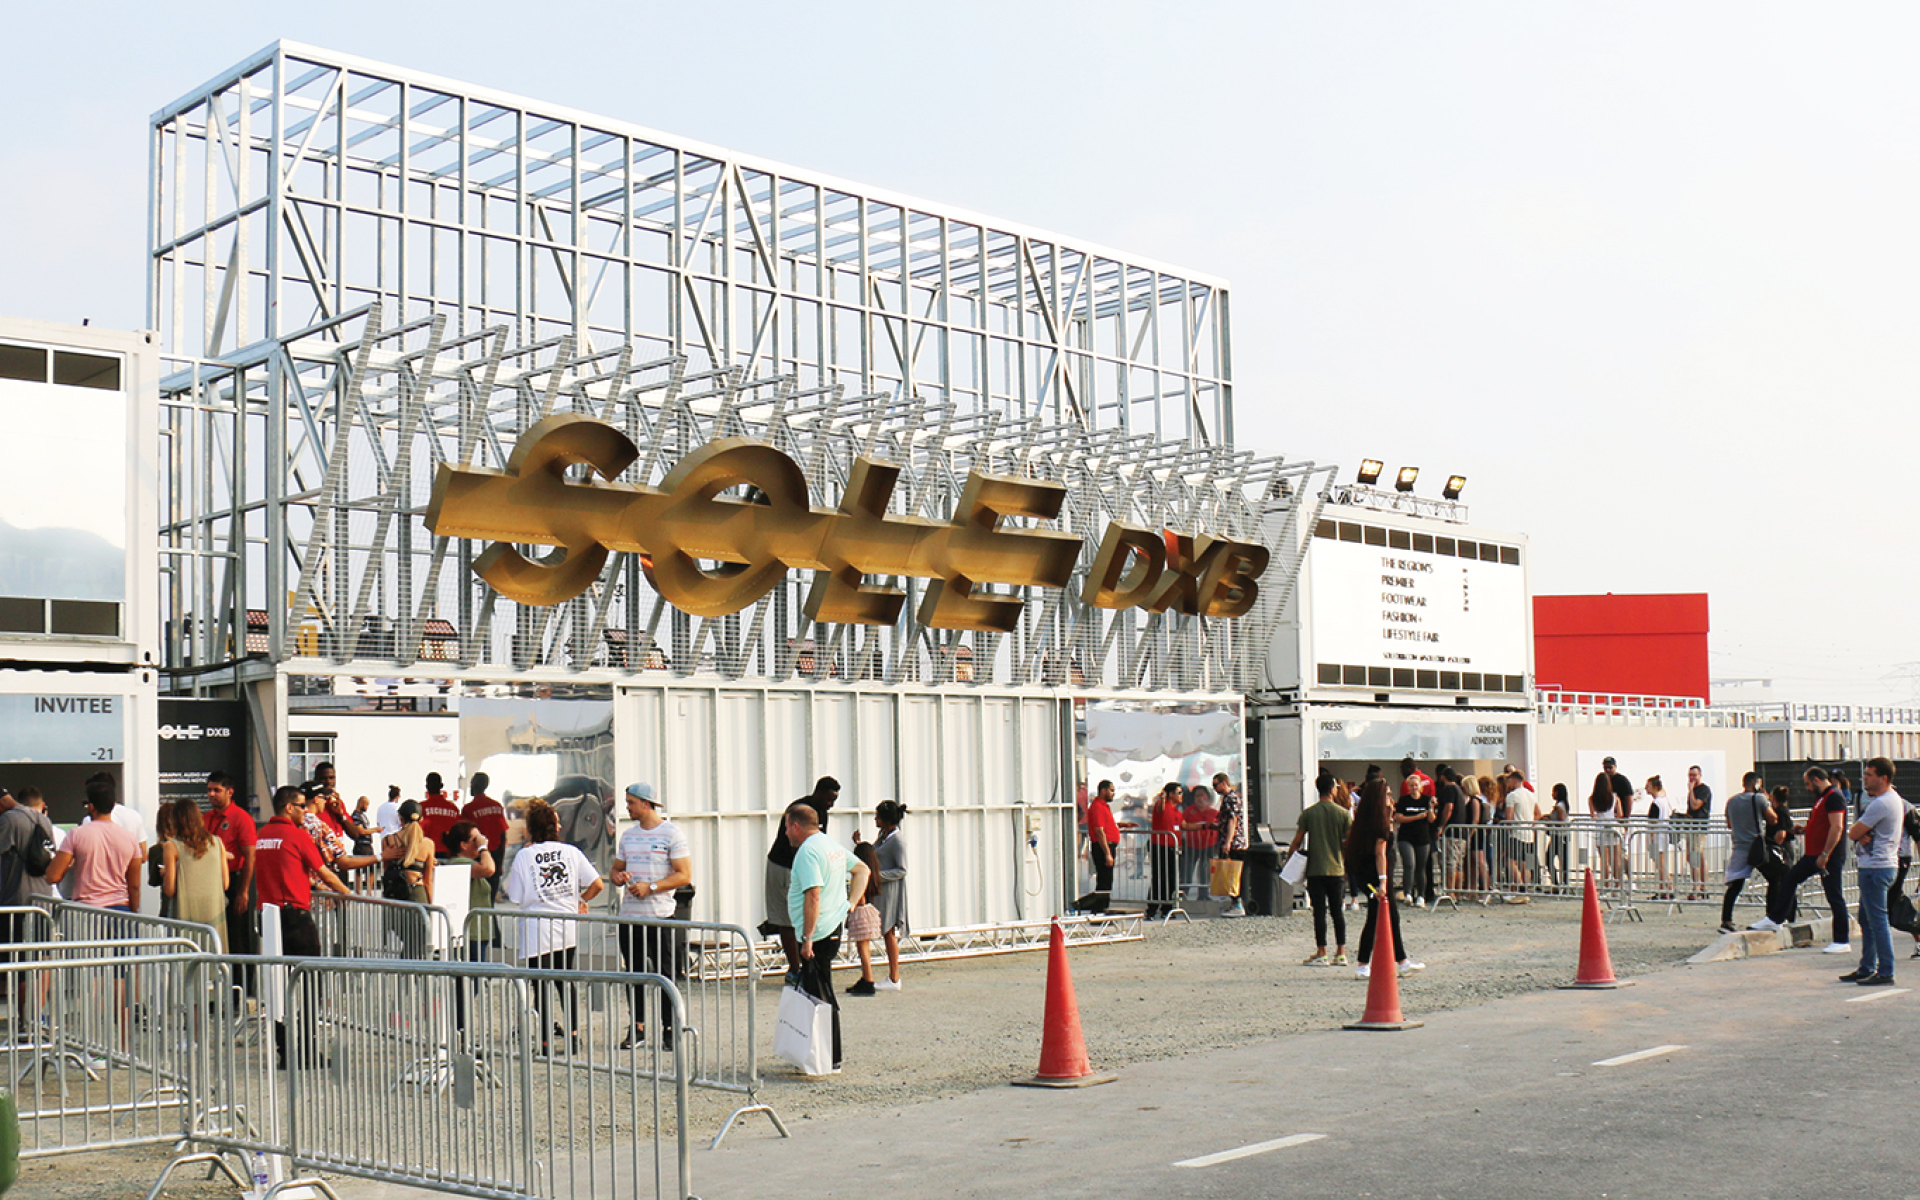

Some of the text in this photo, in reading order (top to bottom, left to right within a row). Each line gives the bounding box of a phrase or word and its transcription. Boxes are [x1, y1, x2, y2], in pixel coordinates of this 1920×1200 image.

[425, 412, 1271, 633] SOLE DXB
[1381, 557, 1396, 569] THE
[1381, 575, 1415, 588] PREMIER
[1381, 592, 1427, 607] FOOTWEAR
[1382, 610, 1417, 623] FASHION
[1382, 628, 1440, 642] LIFESTYLE FAIR
[35, 697, 113, 714] INVITEE
[157, 724, 230, 740] OLE DXB
[1320, 721, 1342, 731] PRESS
[1476, 724, 1503, 734] GENERAL
[1470, 736, 1505, 746] ADMISSION
[91, 748, 113, 760] -21
[425, 806, 458, 819] SECURITY
[535, 850, 562, 864] OBEY
